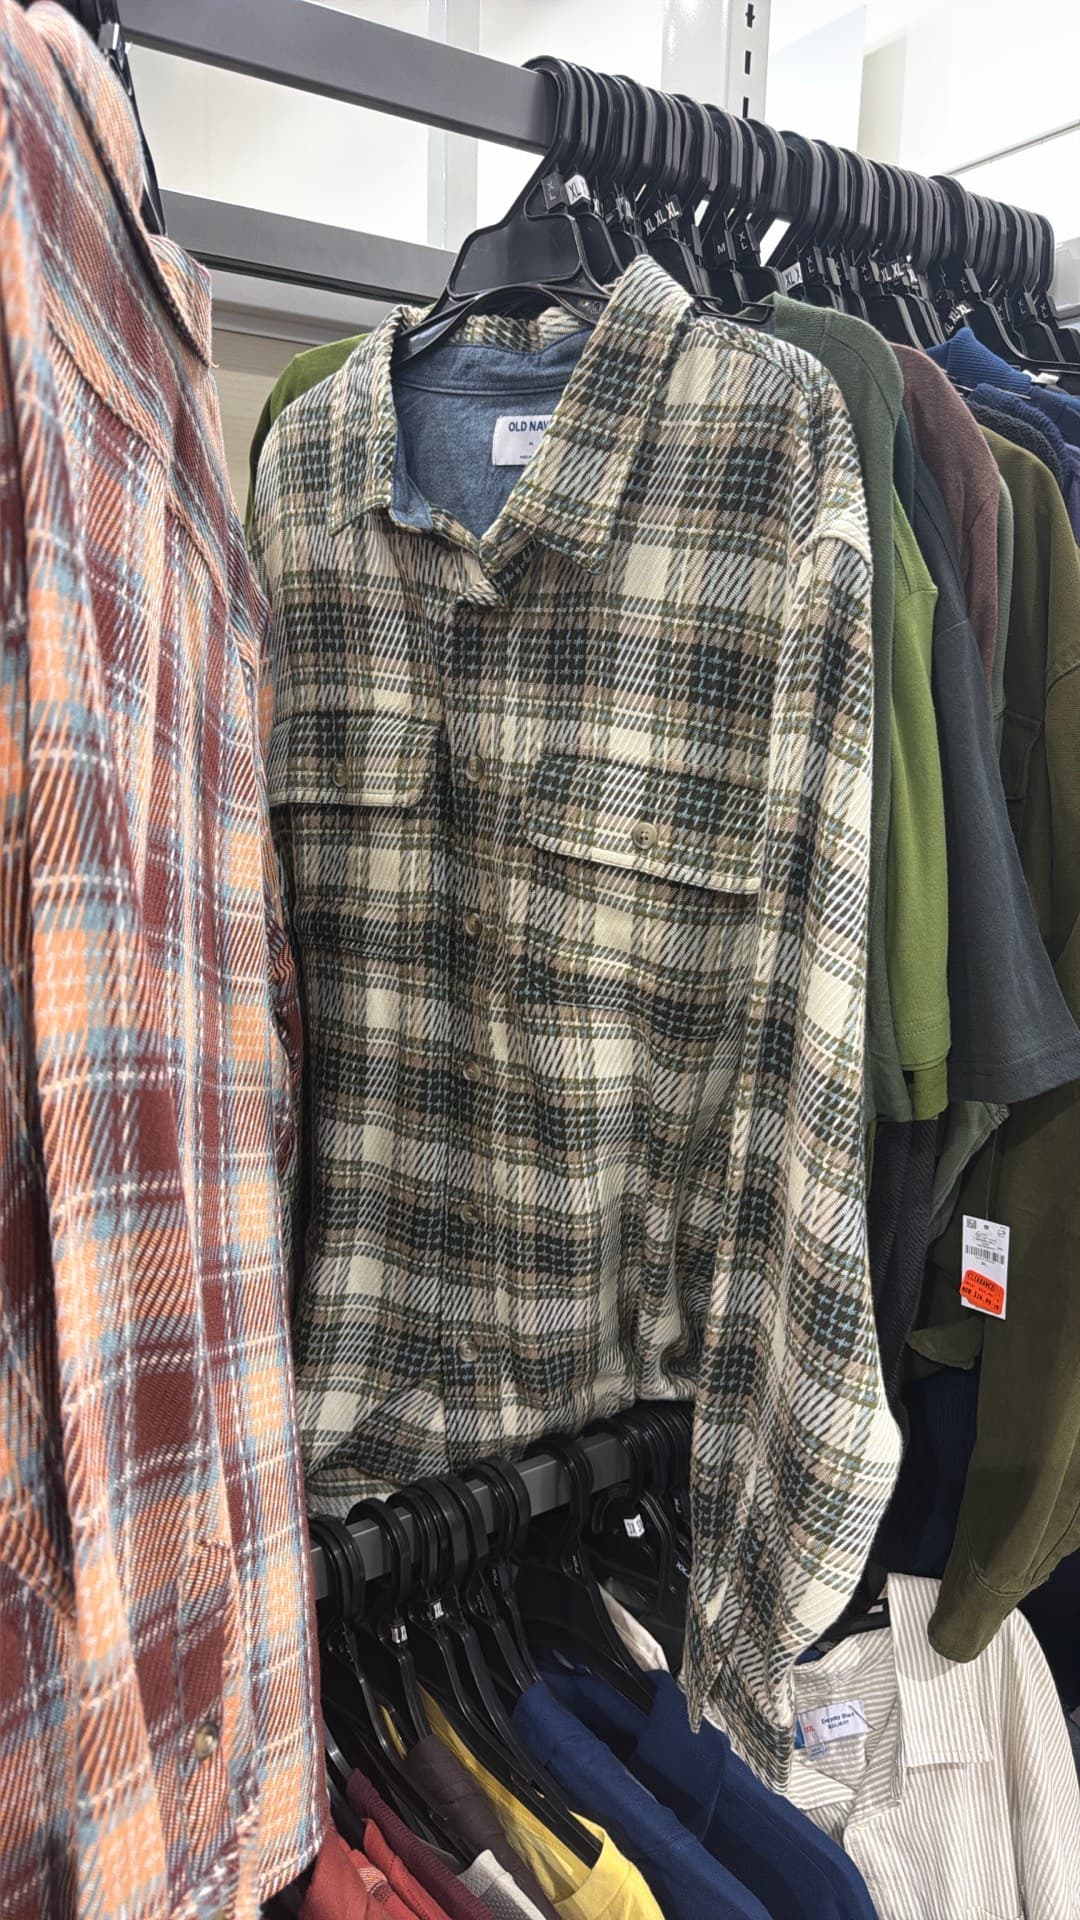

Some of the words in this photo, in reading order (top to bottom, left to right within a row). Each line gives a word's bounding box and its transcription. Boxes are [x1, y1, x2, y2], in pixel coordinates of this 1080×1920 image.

[547, 181, 556, 200] XL
[568, 182, 582, 201] XL
[654, 209, 667, 227] XL
[665, 201, 680, 219] XL
[643, 218, 656, 236] XL
[717, 242, 726, 255] M
[738, 231, 748, 250] XL
[806, 255, 815, 273] XL
[891, 262, 904, 278] XL
[880, 267, 892, 283] XL
[508, 421, 527, 432] OLD
[529, 420, 550, 432] NAV
[967, 1273, 996, 1292] CLEARANCE
